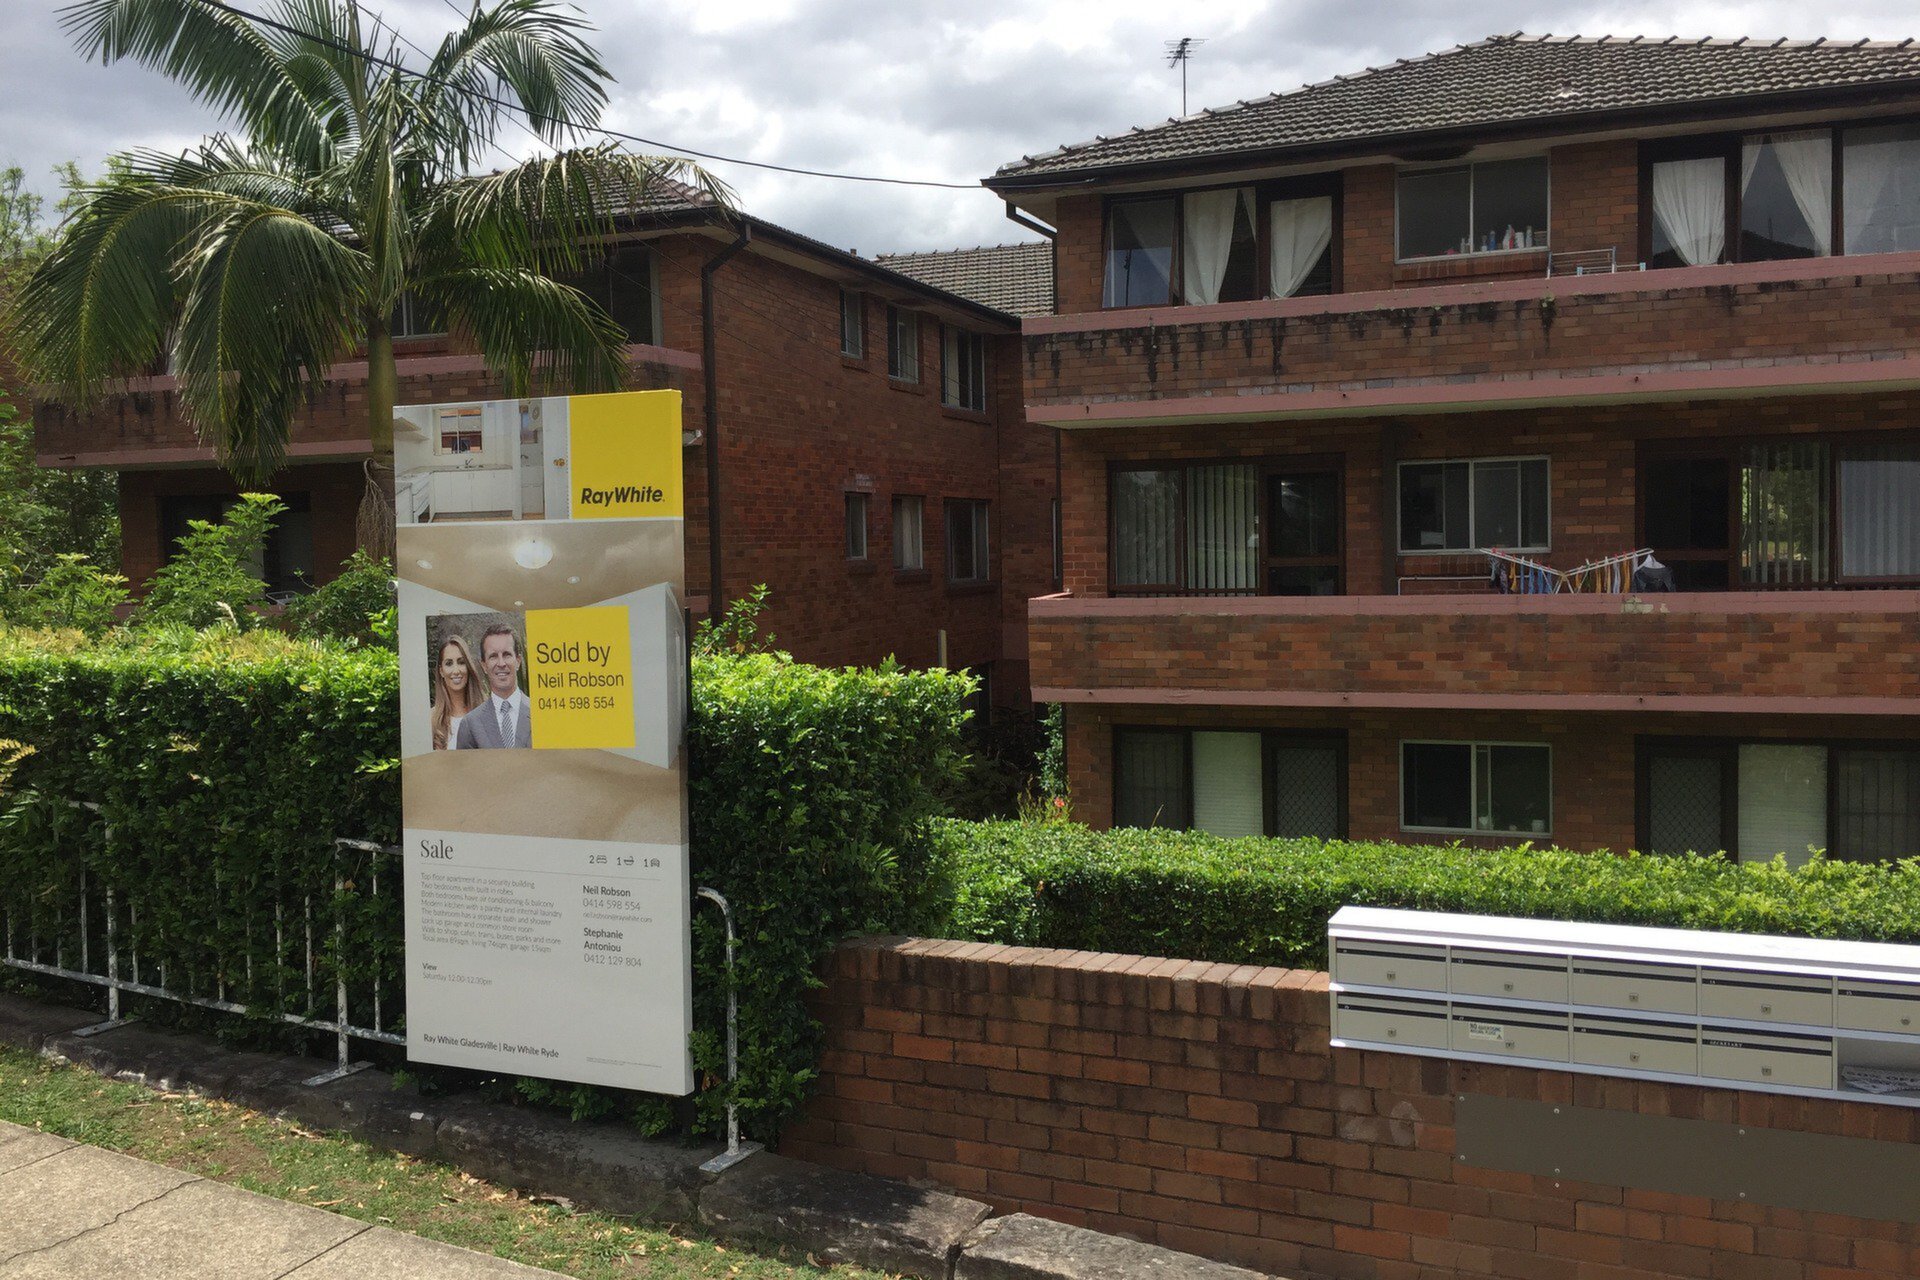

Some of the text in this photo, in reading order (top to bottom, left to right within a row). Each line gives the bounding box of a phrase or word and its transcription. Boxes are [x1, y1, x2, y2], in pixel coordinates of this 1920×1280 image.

[536, 641, 611, 667] Sold by
[537, 672, 624, 689] Neil Robson
[538, 696, 615, 710] 0414 598 554
[420, 839, 454, 860] Sale
[589, 855, 649, 868] 2 1 1
[583, 885, 631, 897] Neil Robson
[583, 898, 640, 911] 0414 598 554
[584, 927, 623, 939] Stephanie
[584, 940, 621, 952] Antoniou
[584, 953, 642, 967] 0412 129 804
[422, 963, 437, 971] View
[423, 1034, 437, 1043] Ray
[437, 1035, 459, 1046] White
[460, 1038, 498, 1050] Gladesville
[503, 1043, 516, 1054] Ray
[517, 1045, 540, 1056] White
[540, 1048, 559, 1058] Ryde
